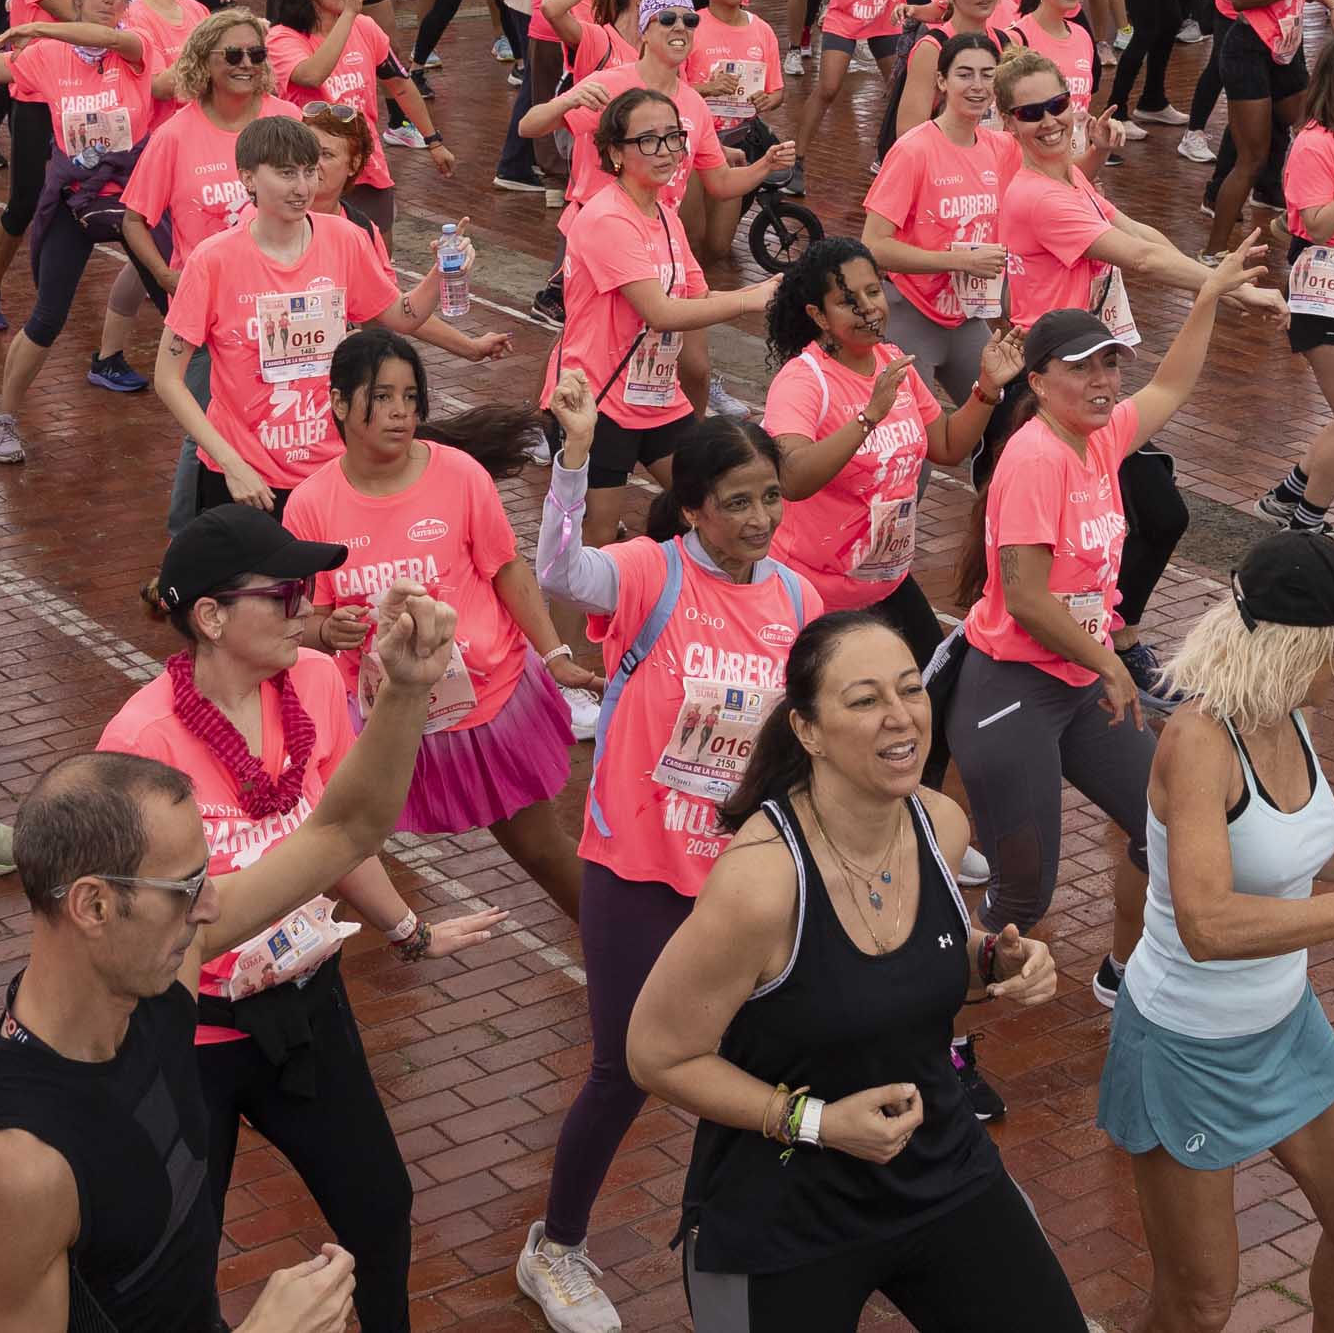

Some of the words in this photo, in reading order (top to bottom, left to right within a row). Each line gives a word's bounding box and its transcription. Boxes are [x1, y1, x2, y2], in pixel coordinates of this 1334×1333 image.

[60, 89, 119, 113] CARRERA
[934, 174, 963, 186] OYSHO
[939, 193, 998, 219] CARRERA
[292, 330, 324, 346] 016
[259, 418, 329, 450] MUJER
[285, 448, 310, 464] 2026
[889, 534, 912, 553] 016
[335, 554, 439, 598] CARRERA
[683, 642, 786, 689] CARRERA
[695, 689, 719, 699] SUMA
[710, 736, 753, 758] 016
[665, 758, 692, 772] CARRERA
[693, 764, 701, 773] DE
[702, 766, 710, 775] LA
[711, 768, 731, 779] MUJER
[716, 758, 736, 770] 2150
[686, 837, 719, 859] 2026
